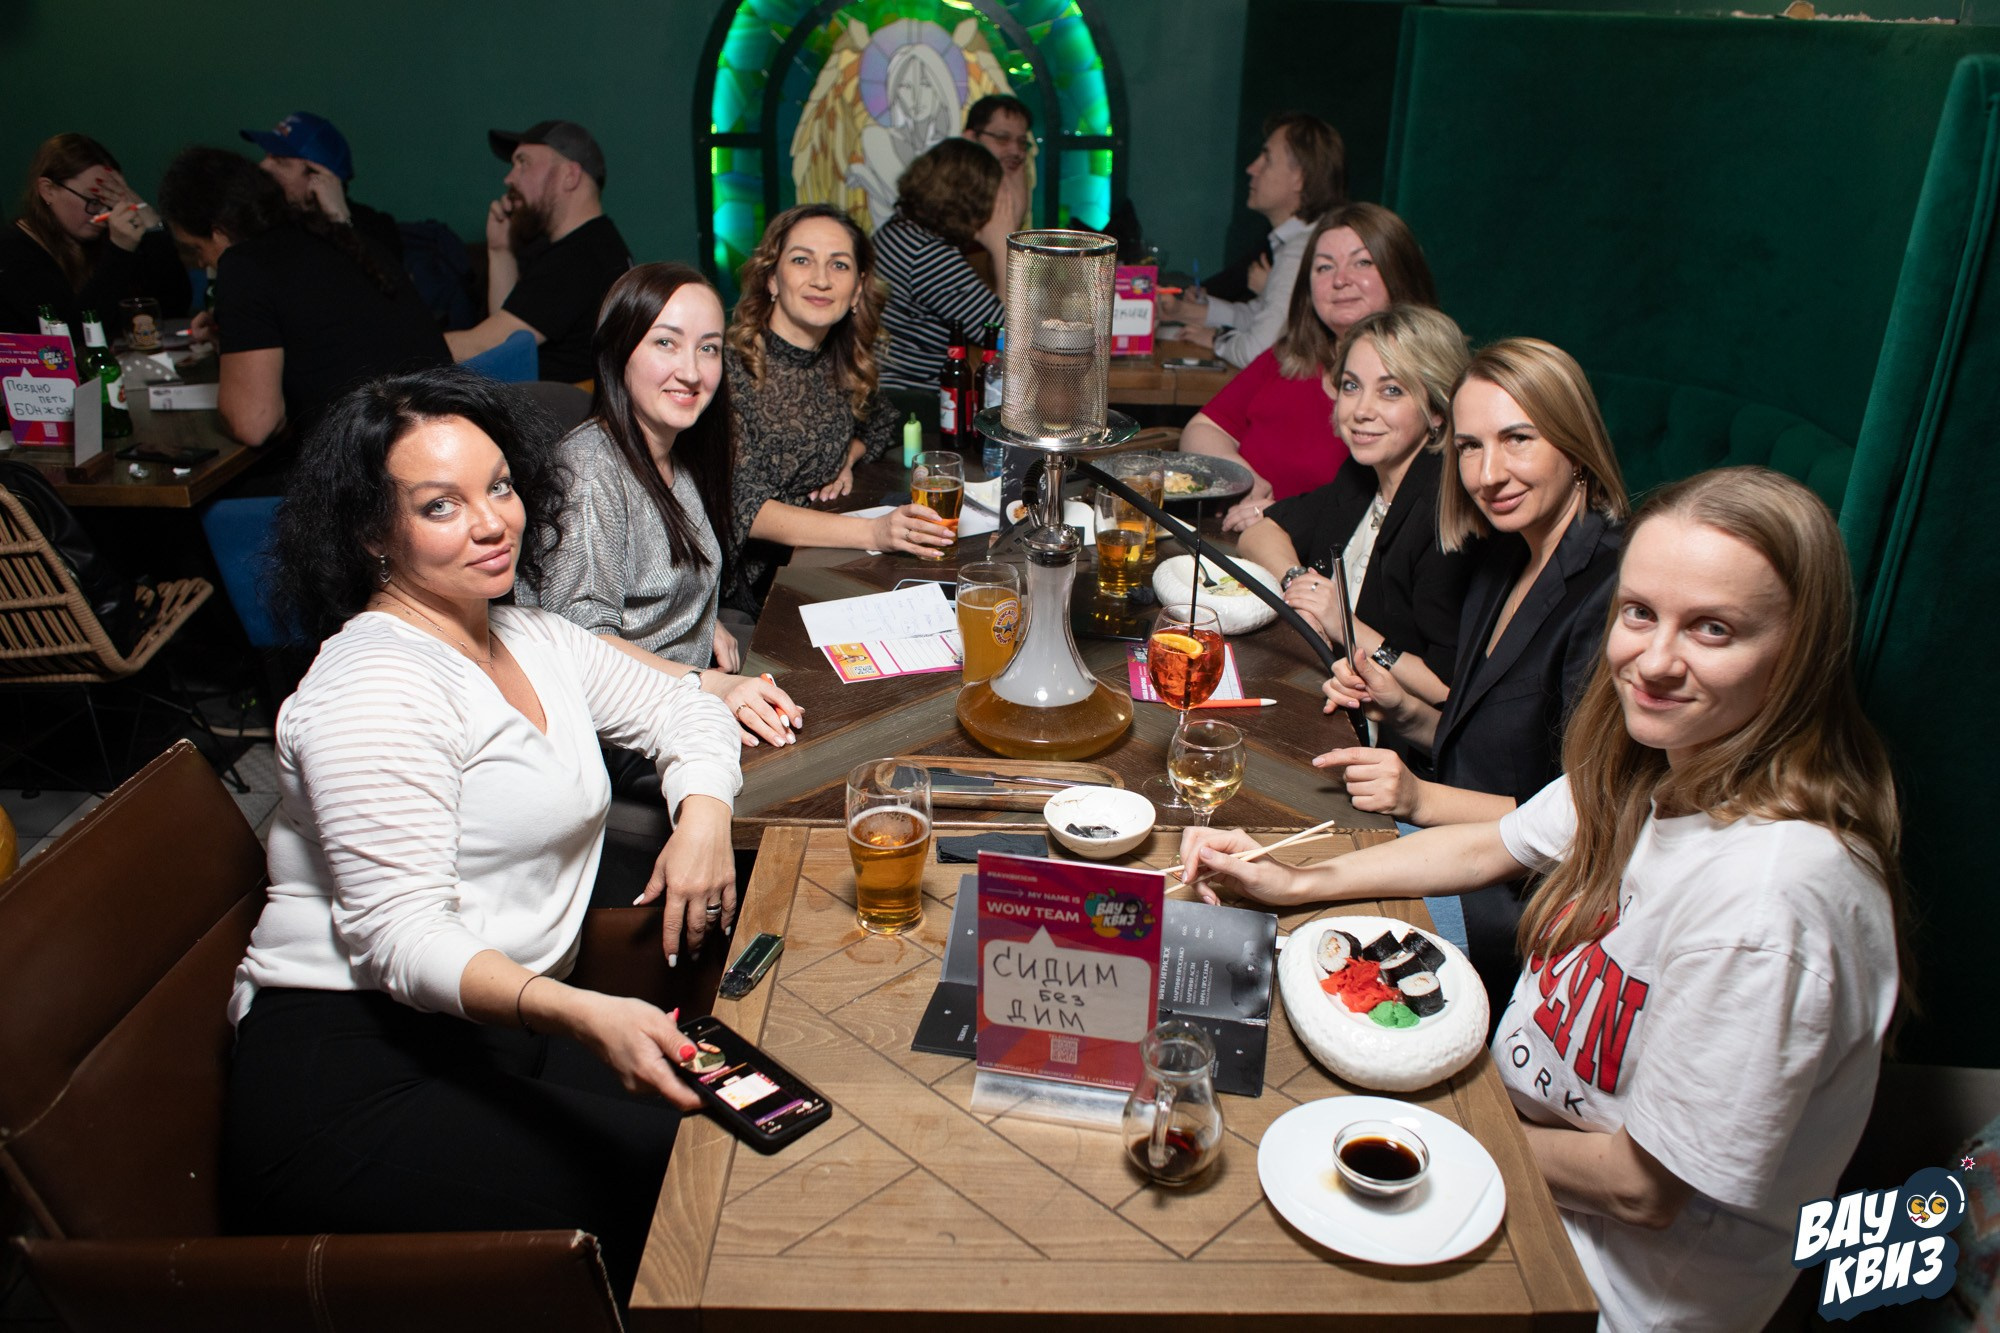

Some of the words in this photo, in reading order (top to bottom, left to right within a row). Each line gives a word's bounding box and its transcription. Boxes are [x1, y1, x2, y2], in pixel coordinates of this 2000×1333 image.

[1027, 891, 1042, 899] MY
[1043, 893, 1070, 902] NAME
[1072, 896, 1080, 904] IS
[986, 901, 1031, 917] WOW
[1034, 906, 1080, 923] TEAM
[1095, 902, 1124, 916] ВАУ
[1103, 914, 1136, 927] КВИЗ
[993, 946, 1118, 988] СИДИМ
[1006, 999, 1086, 1033] ДИМ
